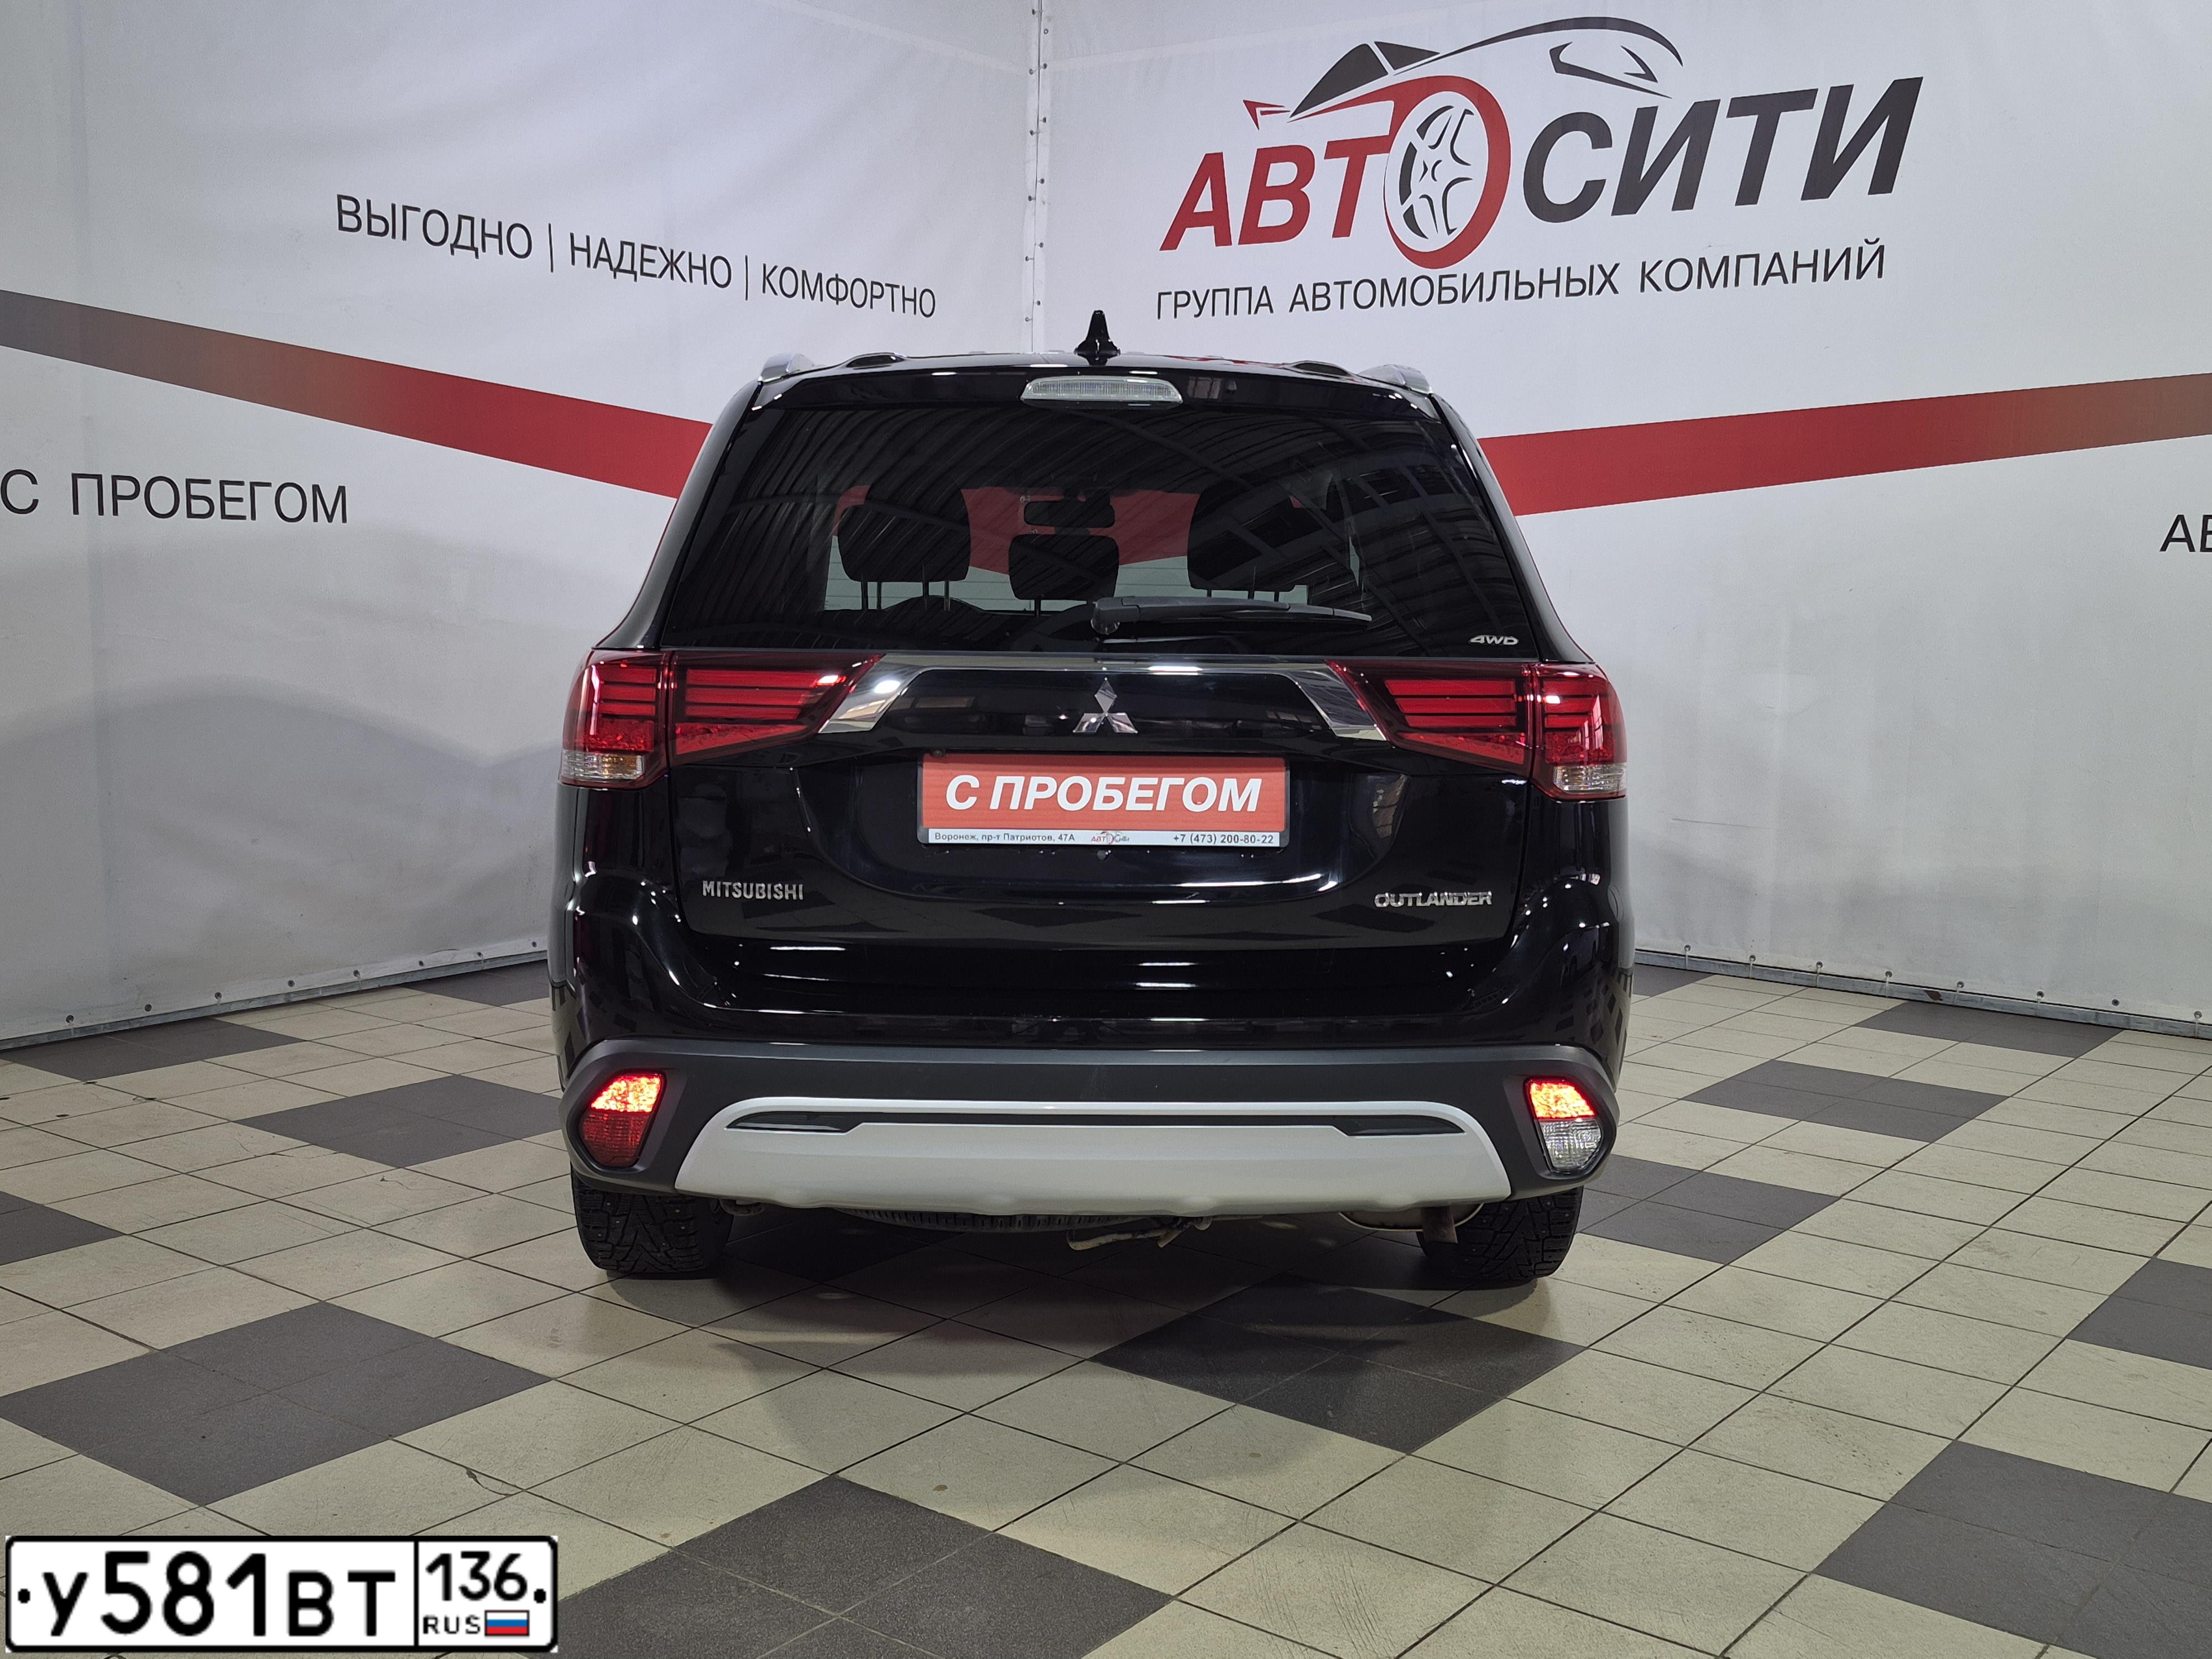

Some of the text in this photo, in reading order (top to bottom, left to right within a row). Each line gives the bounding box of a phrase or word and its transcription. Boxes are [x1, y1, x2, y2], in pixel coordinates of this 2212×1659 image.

[337, 194, 936, 318] ВЫГОДНО НАДЕЖНО КОМФОРТНО
[1157, 237, 1885, 320] ГРУППА АВТОМОБИЛЬНЫХ КОМПАНИЙ
[0, 469, 347, 524] С ПРОБЕГОМ
[1469, 634, 1519, 645] 4WD
[946, 775, 1262, 812] С ПРОБЕГОМ
[935, 832, 1075, 842] Воронеж, пр-т Патриотов, 47А
[1173, 833, 1274, 844] +7 (473) 200-80-22
[702, 880, 804, 900] MITSUBISHI
[1374, 890, 1492, 907] OUTLANDER
